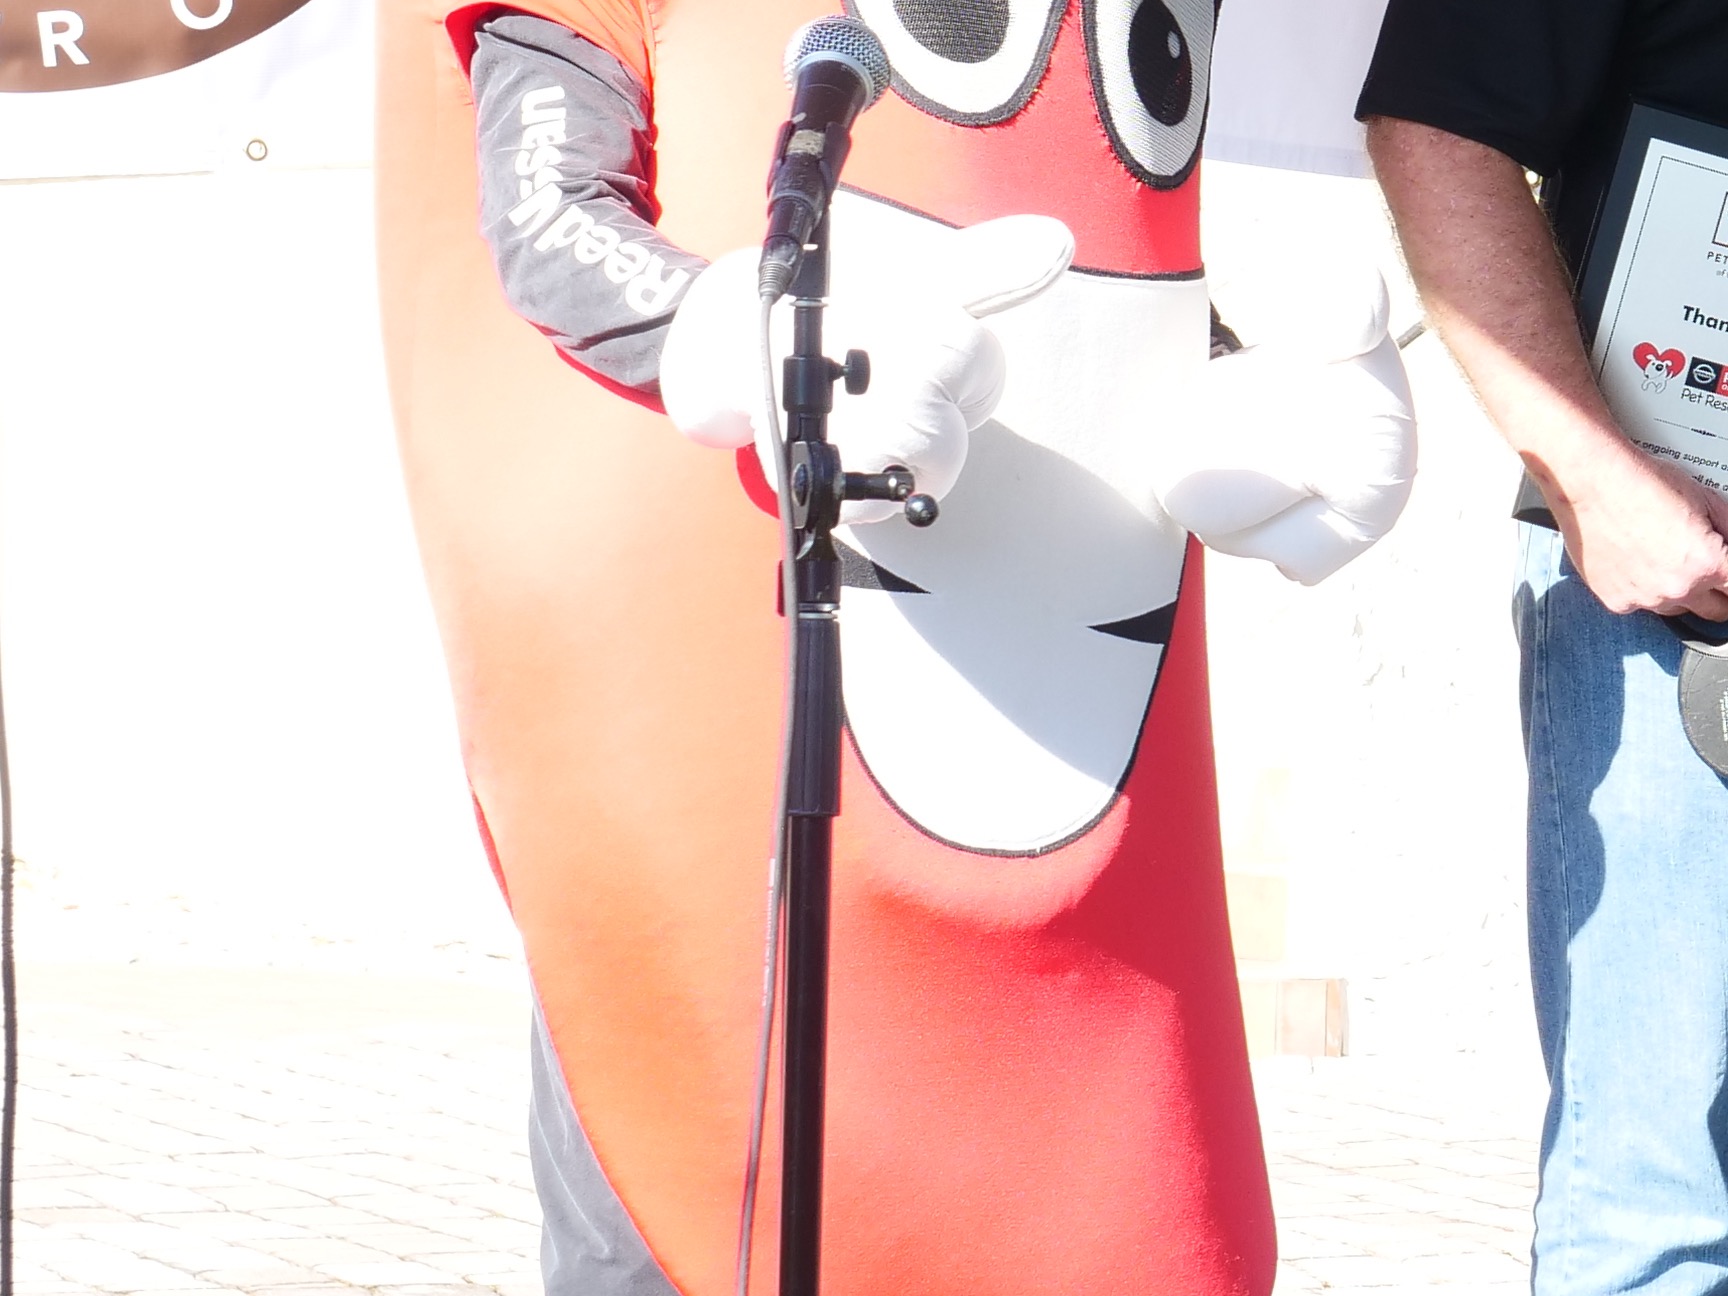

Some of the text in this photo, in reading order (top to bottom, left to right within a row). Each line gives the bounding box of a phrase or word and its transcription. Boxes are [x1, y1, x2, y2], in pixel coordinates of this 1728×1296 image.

[1680, 387, 1703, 404] Pet
[1642, 441, 1681, 460] ongoing
[1683, 452, 1720, 468] support
[1704, 477, 1720, 490] the
